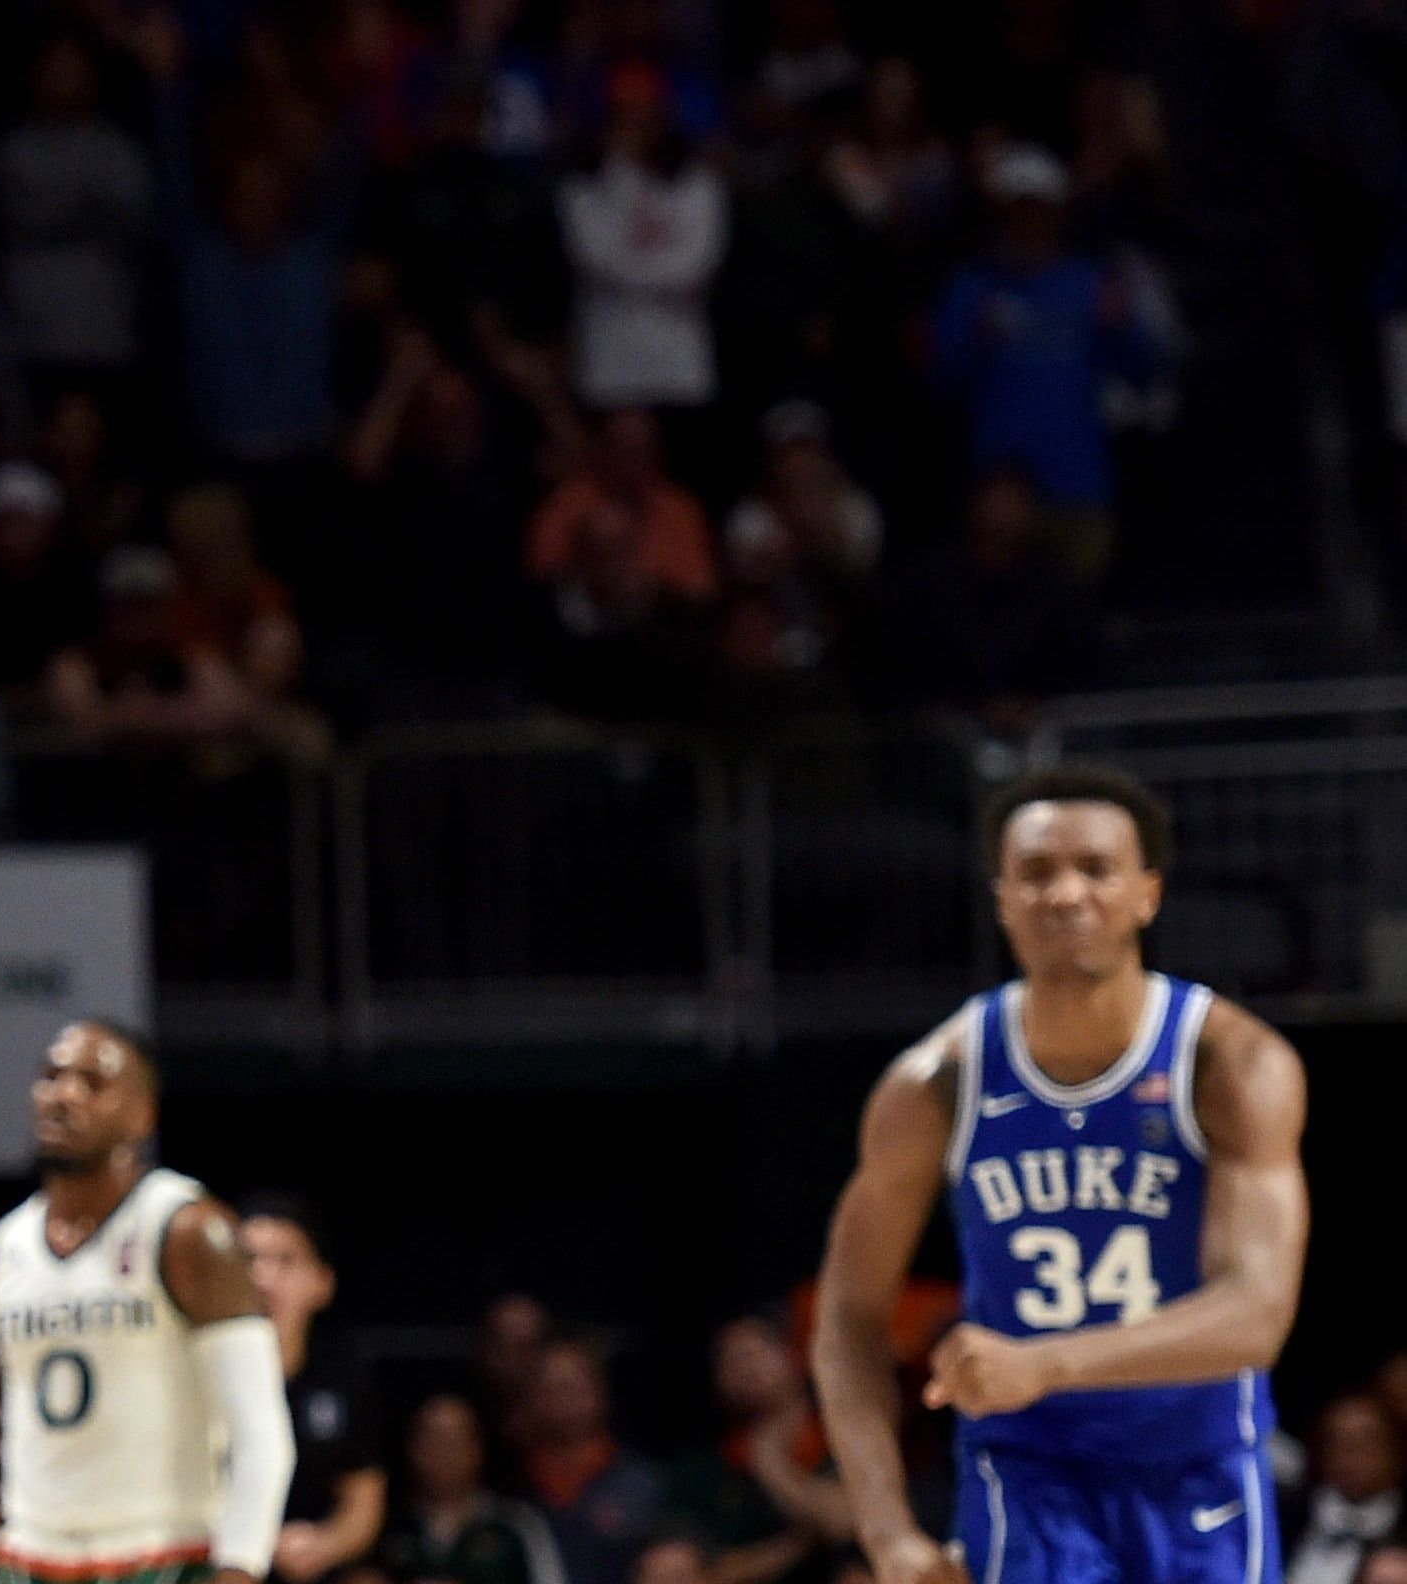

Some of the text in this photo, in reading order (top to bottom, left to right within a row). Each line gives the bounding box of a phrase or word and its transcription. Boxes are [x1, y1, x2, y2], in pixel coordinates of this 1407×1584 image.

[971, 1146, 1181, 1224] DUKE
[1009, 1224, 1161, 1330] 34
[37, 1349, 94, 1429] 0
